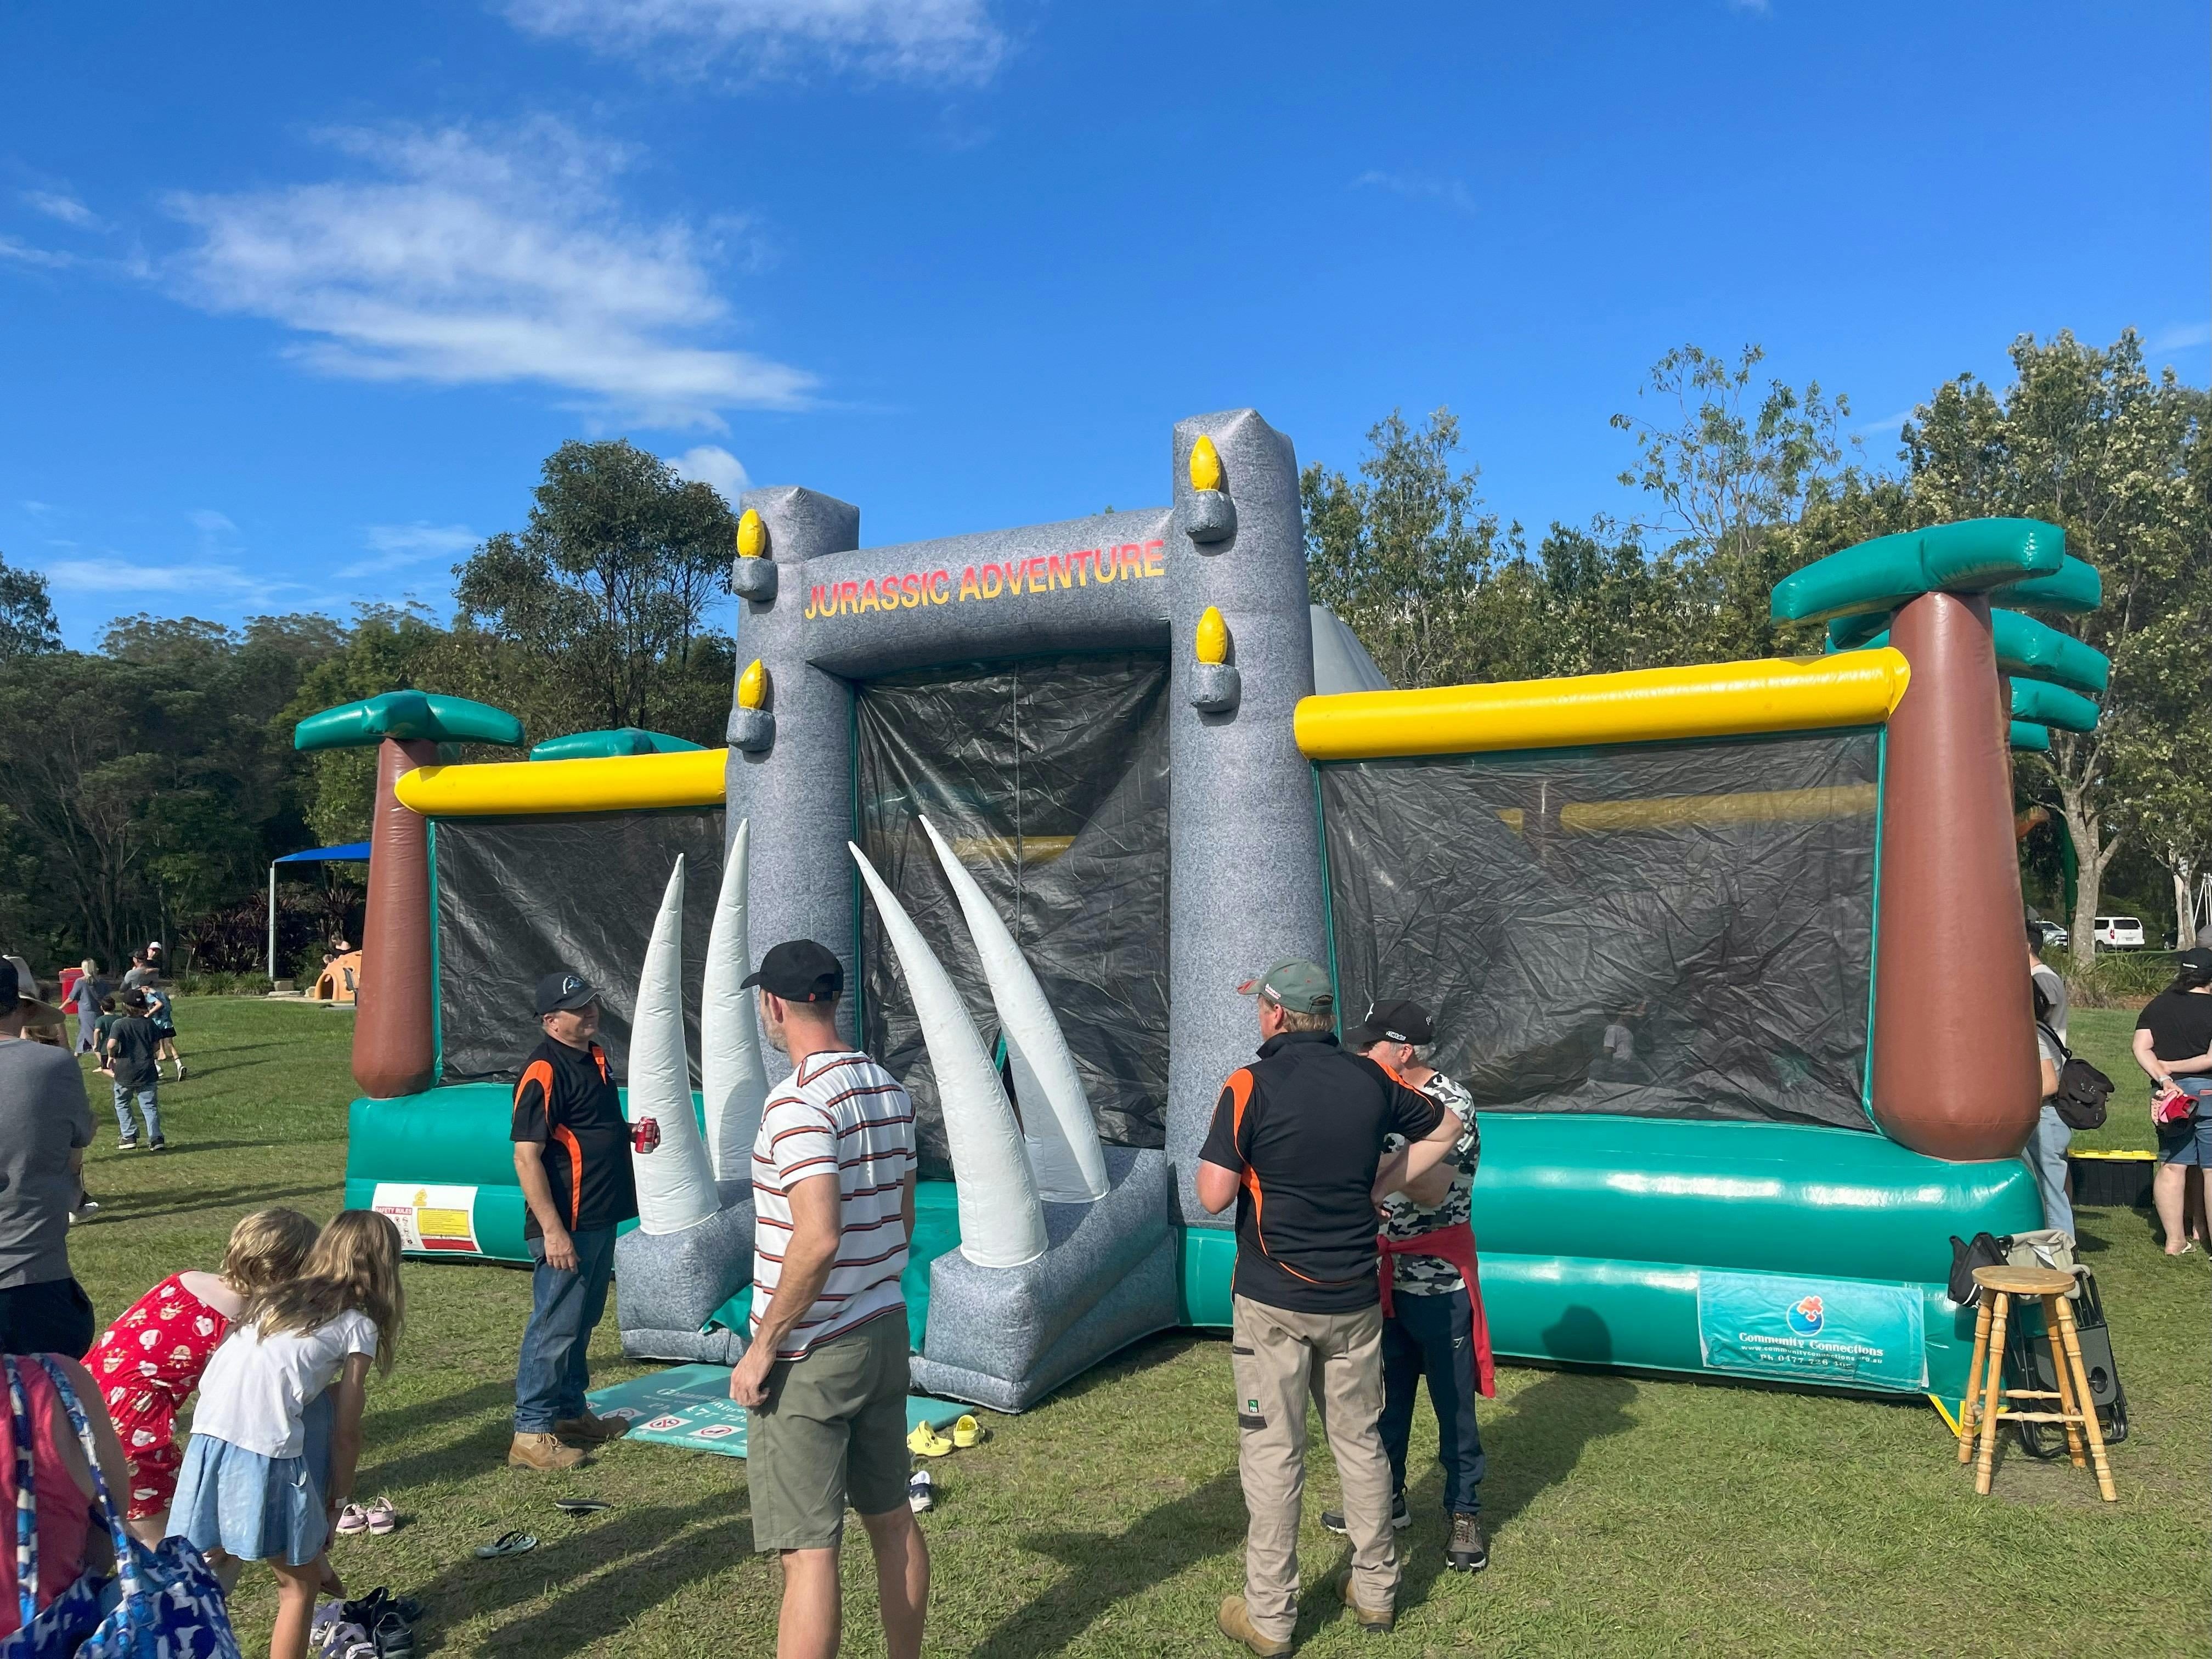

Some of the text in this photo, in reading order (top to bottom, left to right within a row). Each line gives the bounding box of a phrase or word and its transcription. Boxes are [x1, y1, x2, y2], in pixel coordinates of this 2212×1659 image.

[804, 539, 1165, 620] JURASSIC ADVENTURE
[1739, 1332, 1883, 1357] Community Connections
